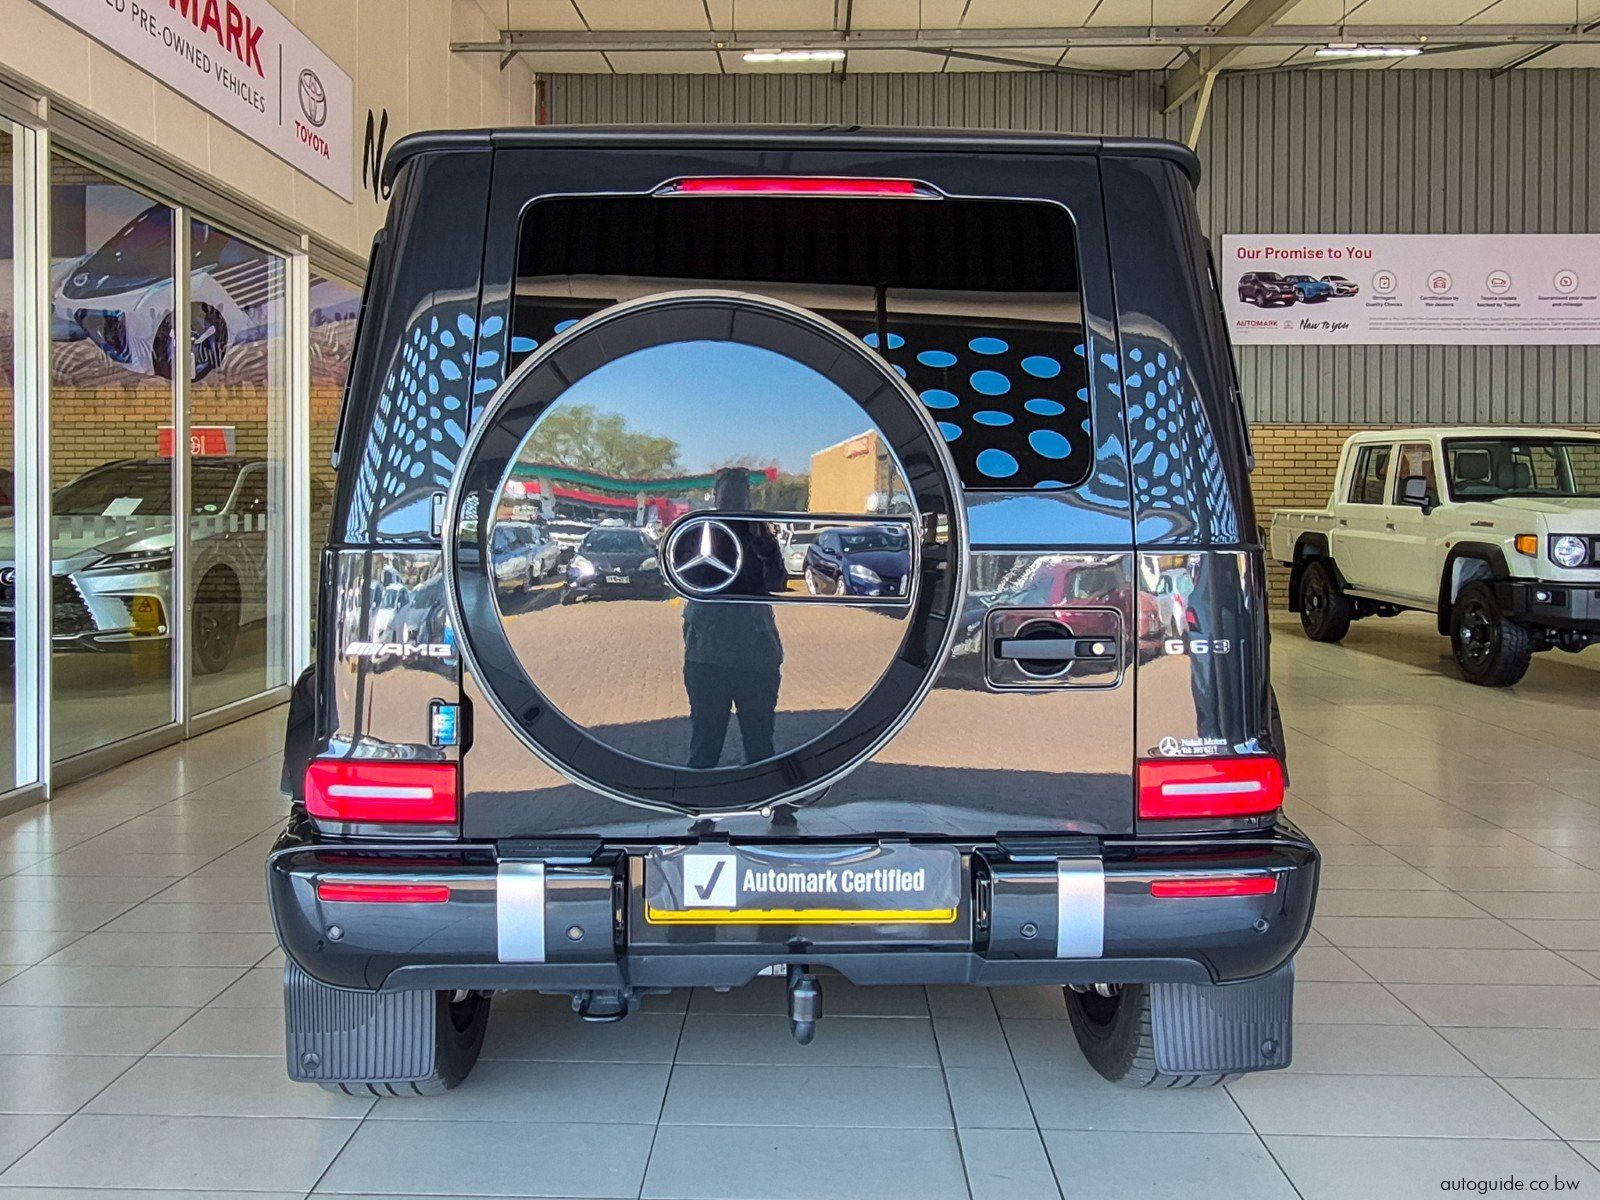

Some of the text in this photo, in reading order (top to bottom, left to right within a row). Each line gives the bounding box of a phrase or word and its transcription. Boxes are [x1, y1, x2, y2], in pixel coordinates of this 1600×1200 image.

[131, 2, 211, 74] PRE-OWNED
[215, 62, 266, 114] VEHICLES
[295, 120, 330, 160] TOYOTA
[1237, 247, 1372, 259] Our Promise to You
[1300, 318, 1320, 330] New
[378, 643, 451, 656] AMG
[743, 869, 925, 893] Automark Certified
